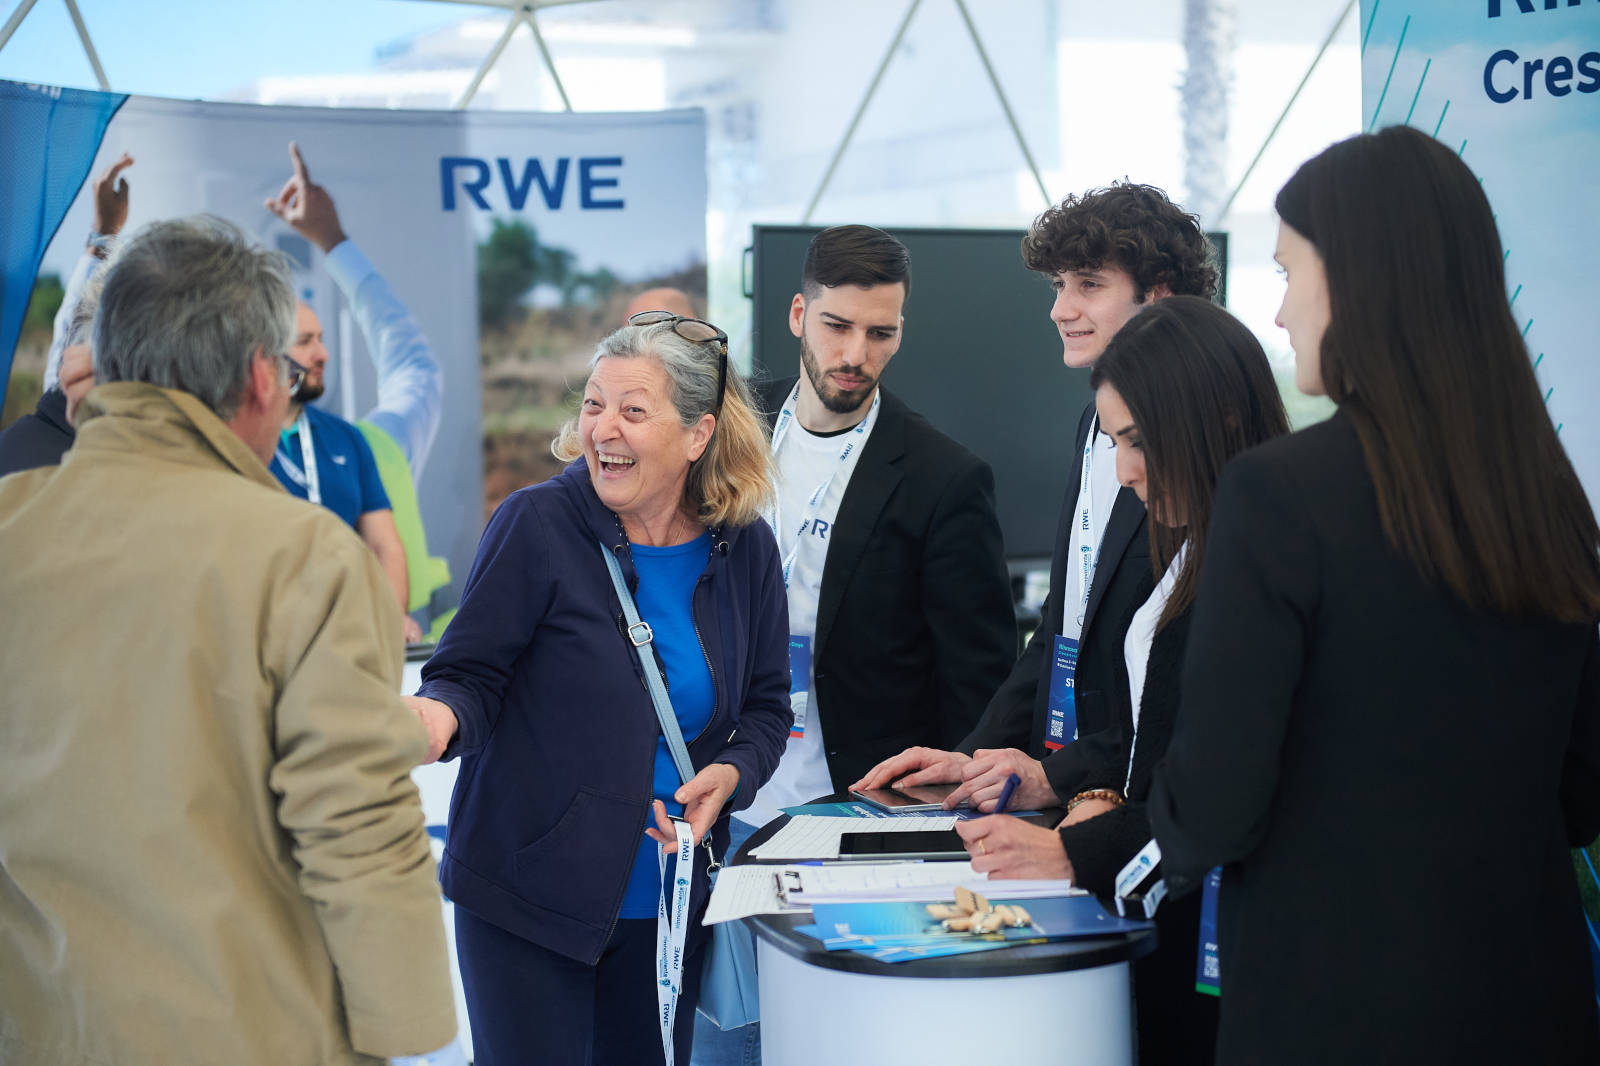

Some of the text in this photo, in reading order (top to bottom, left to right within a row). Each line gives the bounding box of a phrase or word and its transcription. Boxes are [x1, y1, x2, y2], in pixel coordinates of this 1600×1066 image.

[1483, 49, 1600, 104] Cres
[439, 156, 625, 212] RWE
[840, 443, 854, 461] RWE
[811, 518, 834, 539] R
[681, 838, 690, 861] RWE
[673, 946, 681, 970] RWE
